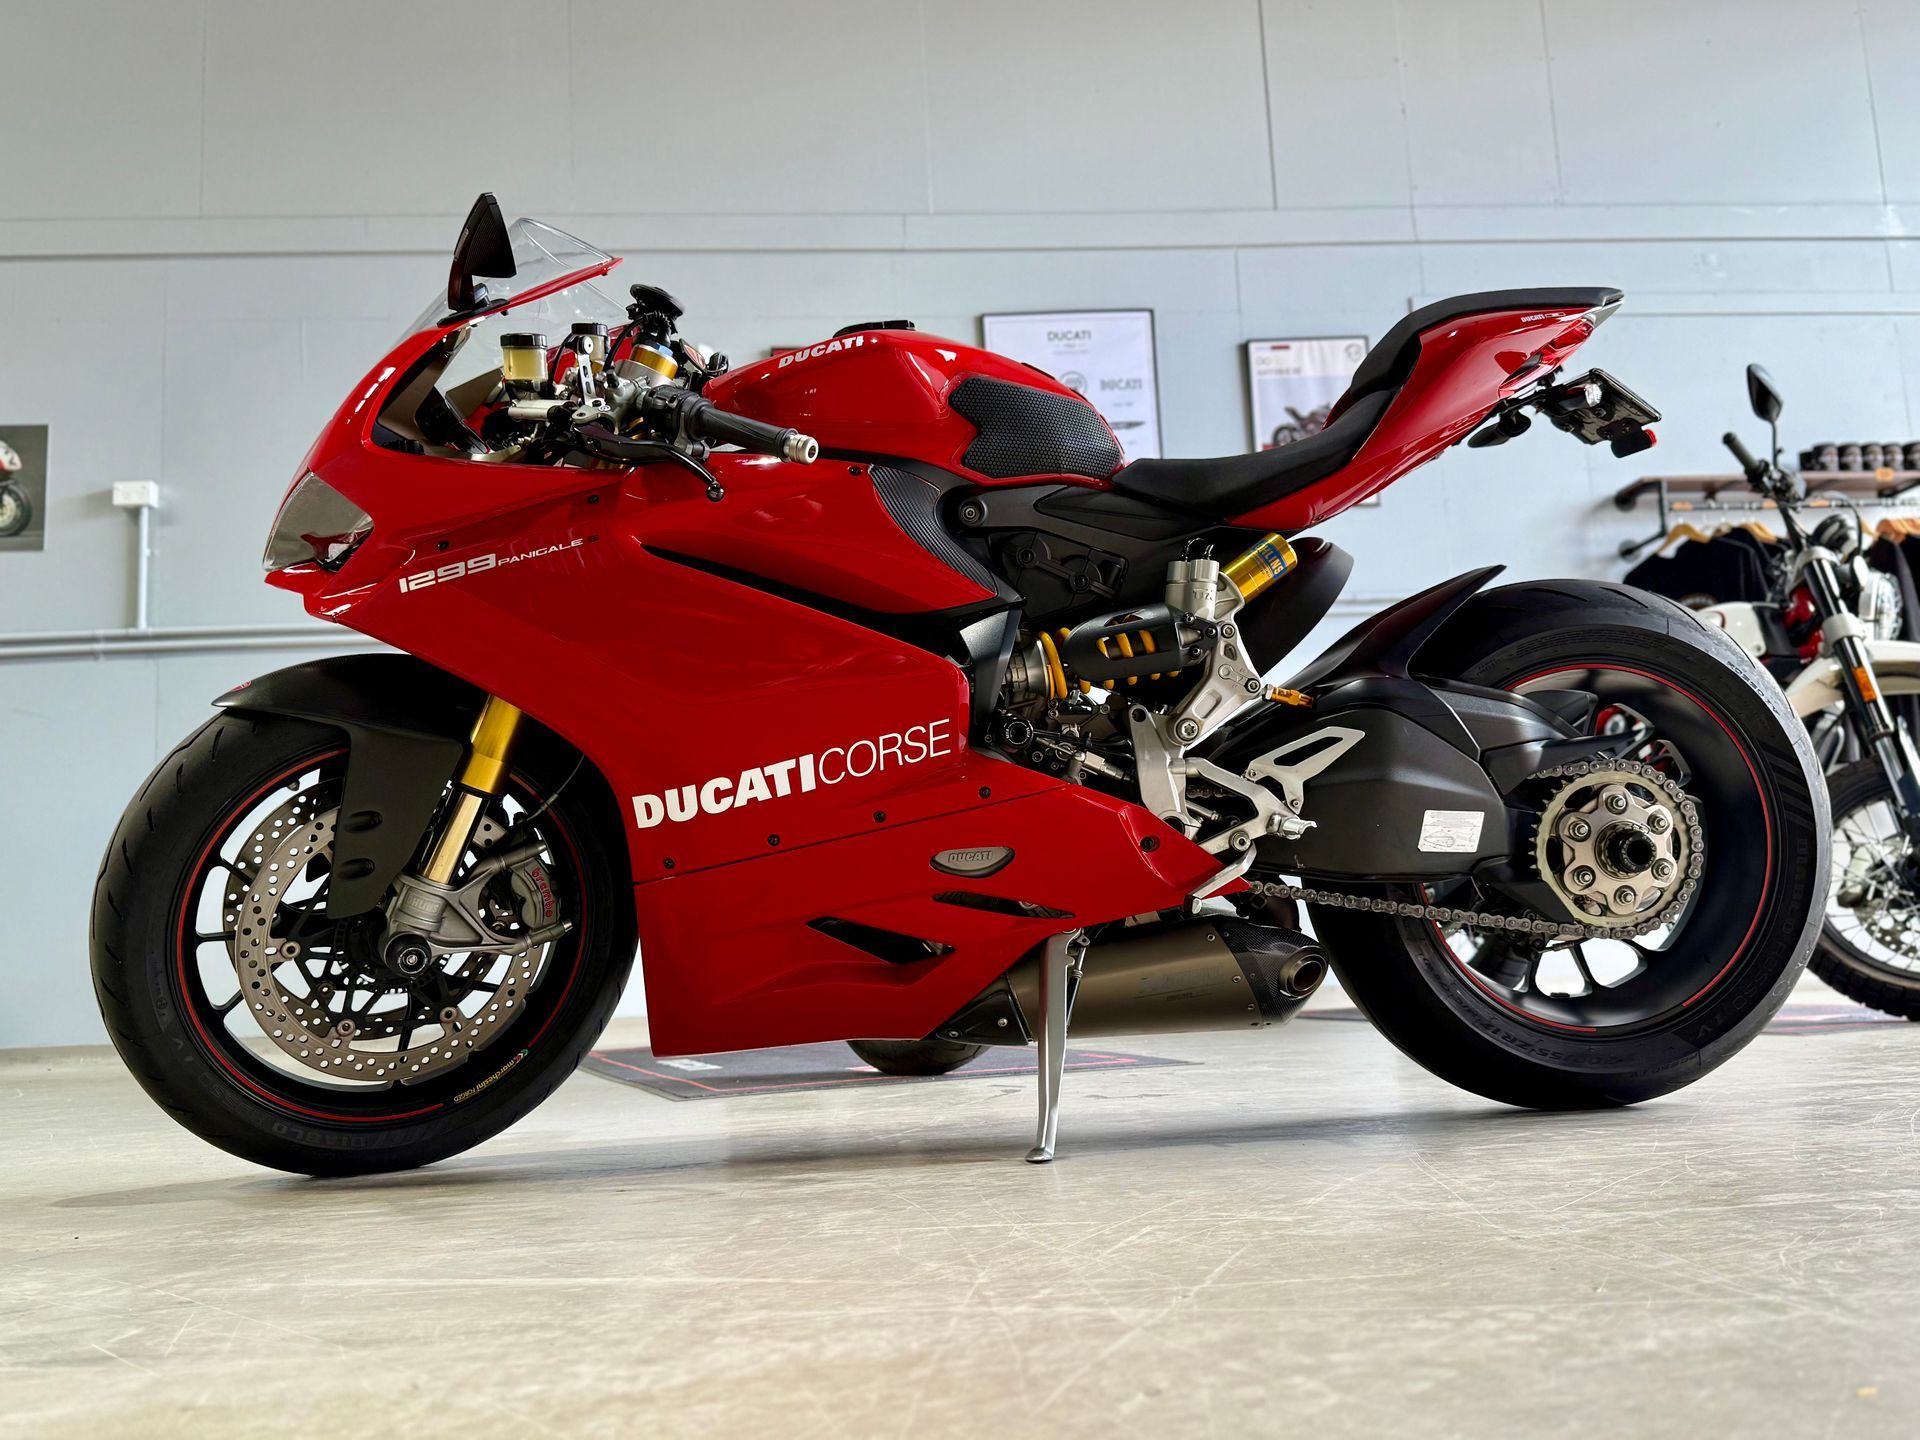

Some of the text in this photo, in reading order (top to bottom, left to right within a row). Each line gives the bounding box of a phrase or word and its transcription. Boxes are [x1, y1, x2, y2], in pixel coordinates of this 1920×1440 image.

[778, 335, 864, 368] DUCATI
[1047, 330, 1091, 341] DUCATI
[1100, 379, 1142, 391] DUCATI
[399, 553, 496, 593] 1299
[498, 538, 583, 566] PANIGALE
[632, 718, 951, 829] DUCATI CORSE
[948, 850, 993, 863] DUCATI
[531, 866, 555, 918] brembo
[475, 1059, 516, 1092] marchesini
